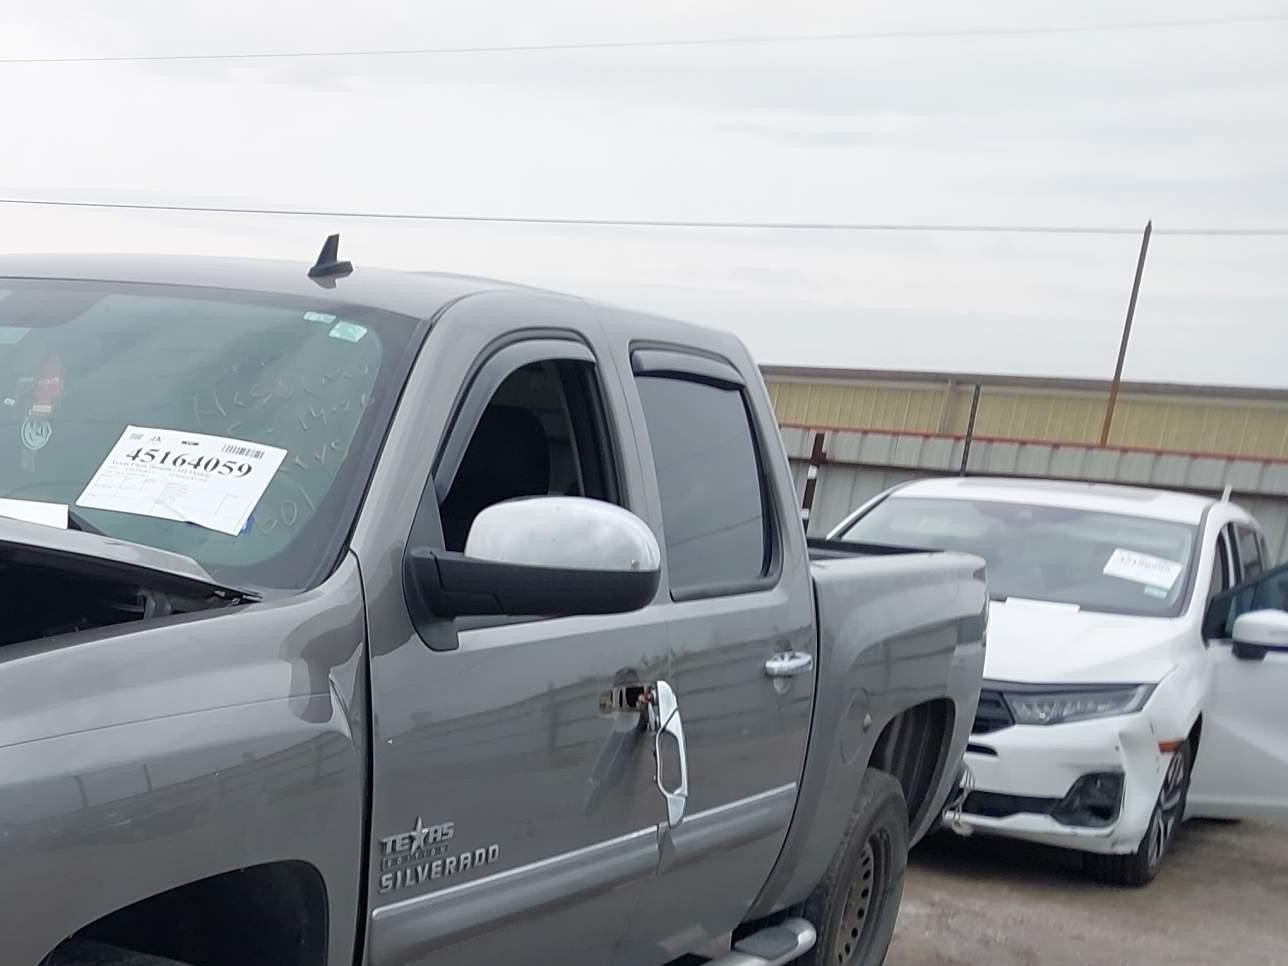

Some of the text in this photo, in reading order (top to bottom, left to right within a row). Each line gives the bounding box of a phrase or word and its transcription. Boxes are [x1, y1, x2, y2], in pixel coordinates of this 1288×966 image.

[126, 447, 253, 478] 45164059
[380, 815, 455, 855] TEXAS
[380, 844, 500, 893] SILVERADO
